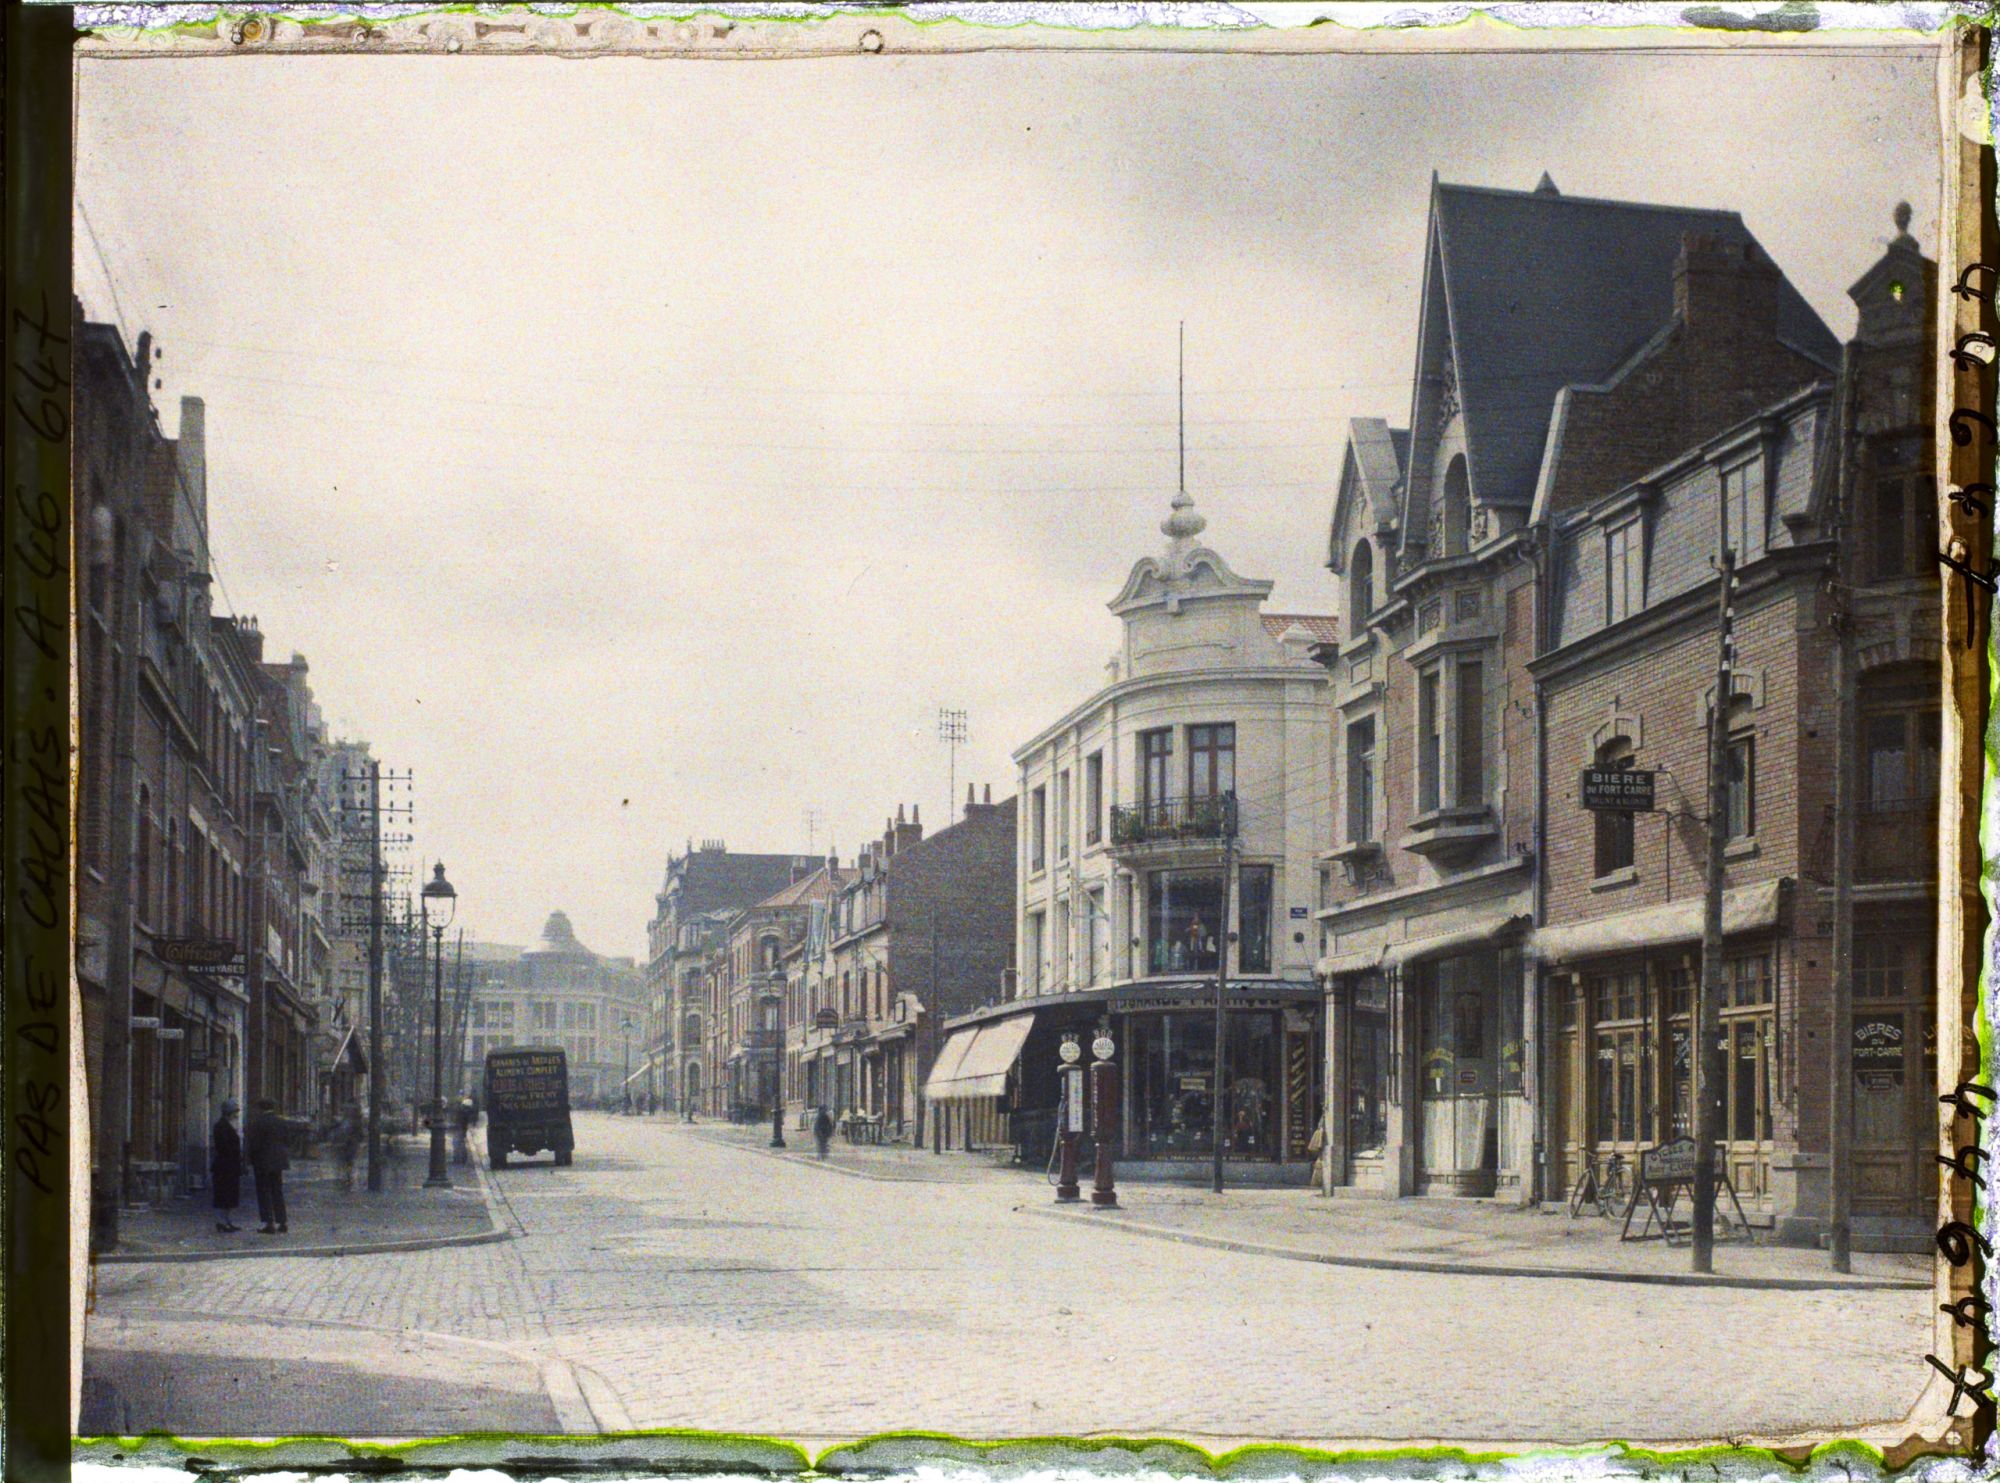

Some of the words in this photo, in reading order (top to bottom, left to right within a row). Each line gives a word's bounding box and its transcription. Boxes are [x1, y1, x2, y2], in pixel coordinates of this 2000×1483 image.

[1599, 785, 1622, 795] FORT
[16, 955, 59, 1054] DE
[1855, 1023, 1902, 1040] BIERES
[15, 1081, 62, 1194] PAS
